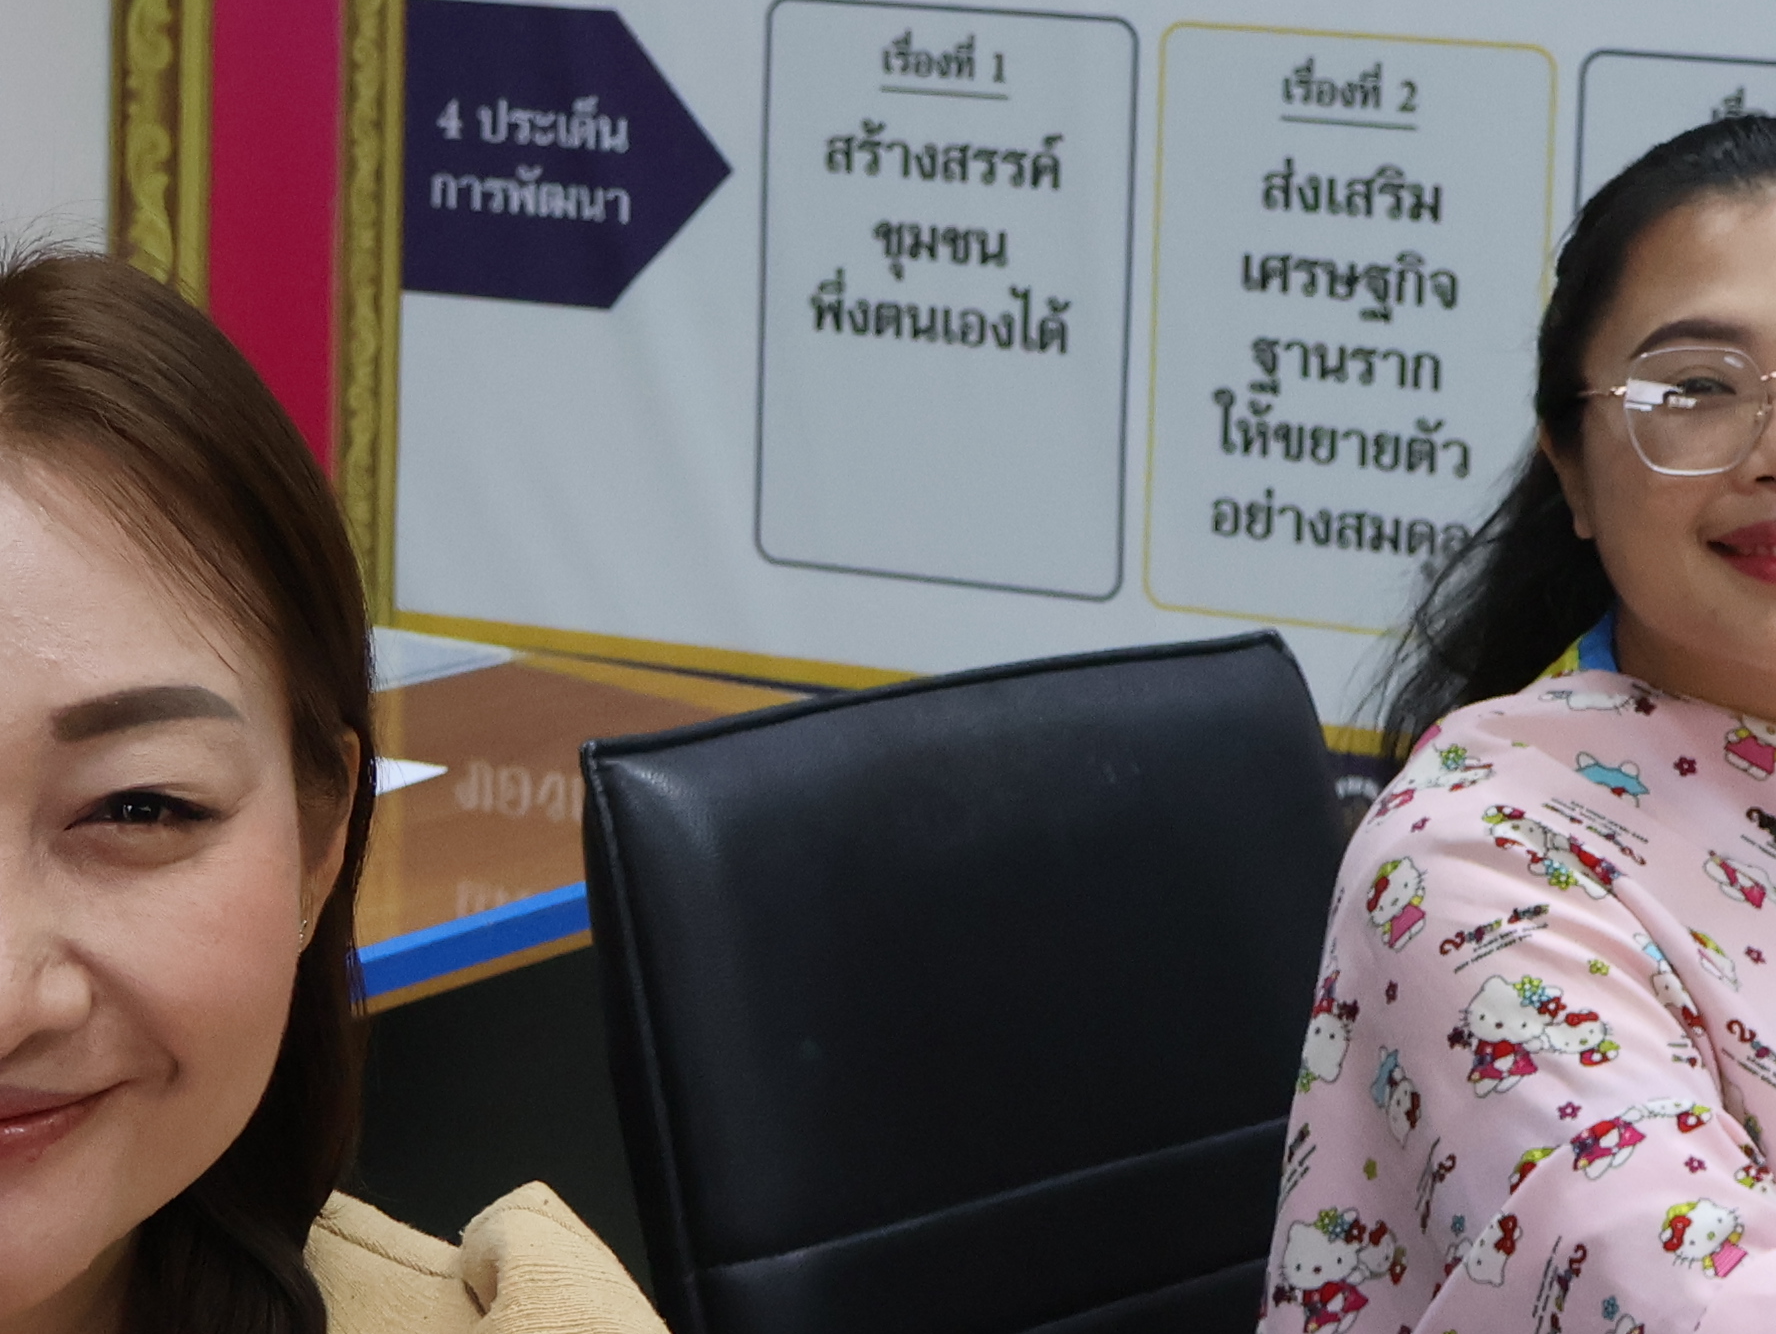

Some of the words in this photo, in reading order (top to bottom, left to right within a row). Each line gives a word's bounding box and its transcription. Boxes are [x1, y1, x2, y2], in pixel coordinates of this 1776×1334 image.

[882, 27, 976, 81] เรื่องที่
[992, 52, 1006, 83] 1
[1283, 55, 1382, 110] เรื่องที่
[1396, 80, 1418, 112] 2
[436, 97, 463, 140] 4
[476, 95, 629, 154] ประเด็น
[826, 118, 1064, 190] สร้างสรรค์
[429, 165, 631, 225] การพัฒนา
[1262, 155, 1442, 224] ส่งเสริม
[874, 220, 1009, 281] ชุมชน
[809, 267, 1072, 355] พึ่งตนเองได้
[1242, 250, 1460, 323] เศรษฐกิจ
[1247, 336, 1442, 397] ฐานราก
[1211, 387, 1471, 479] ให้ขยายตัว
